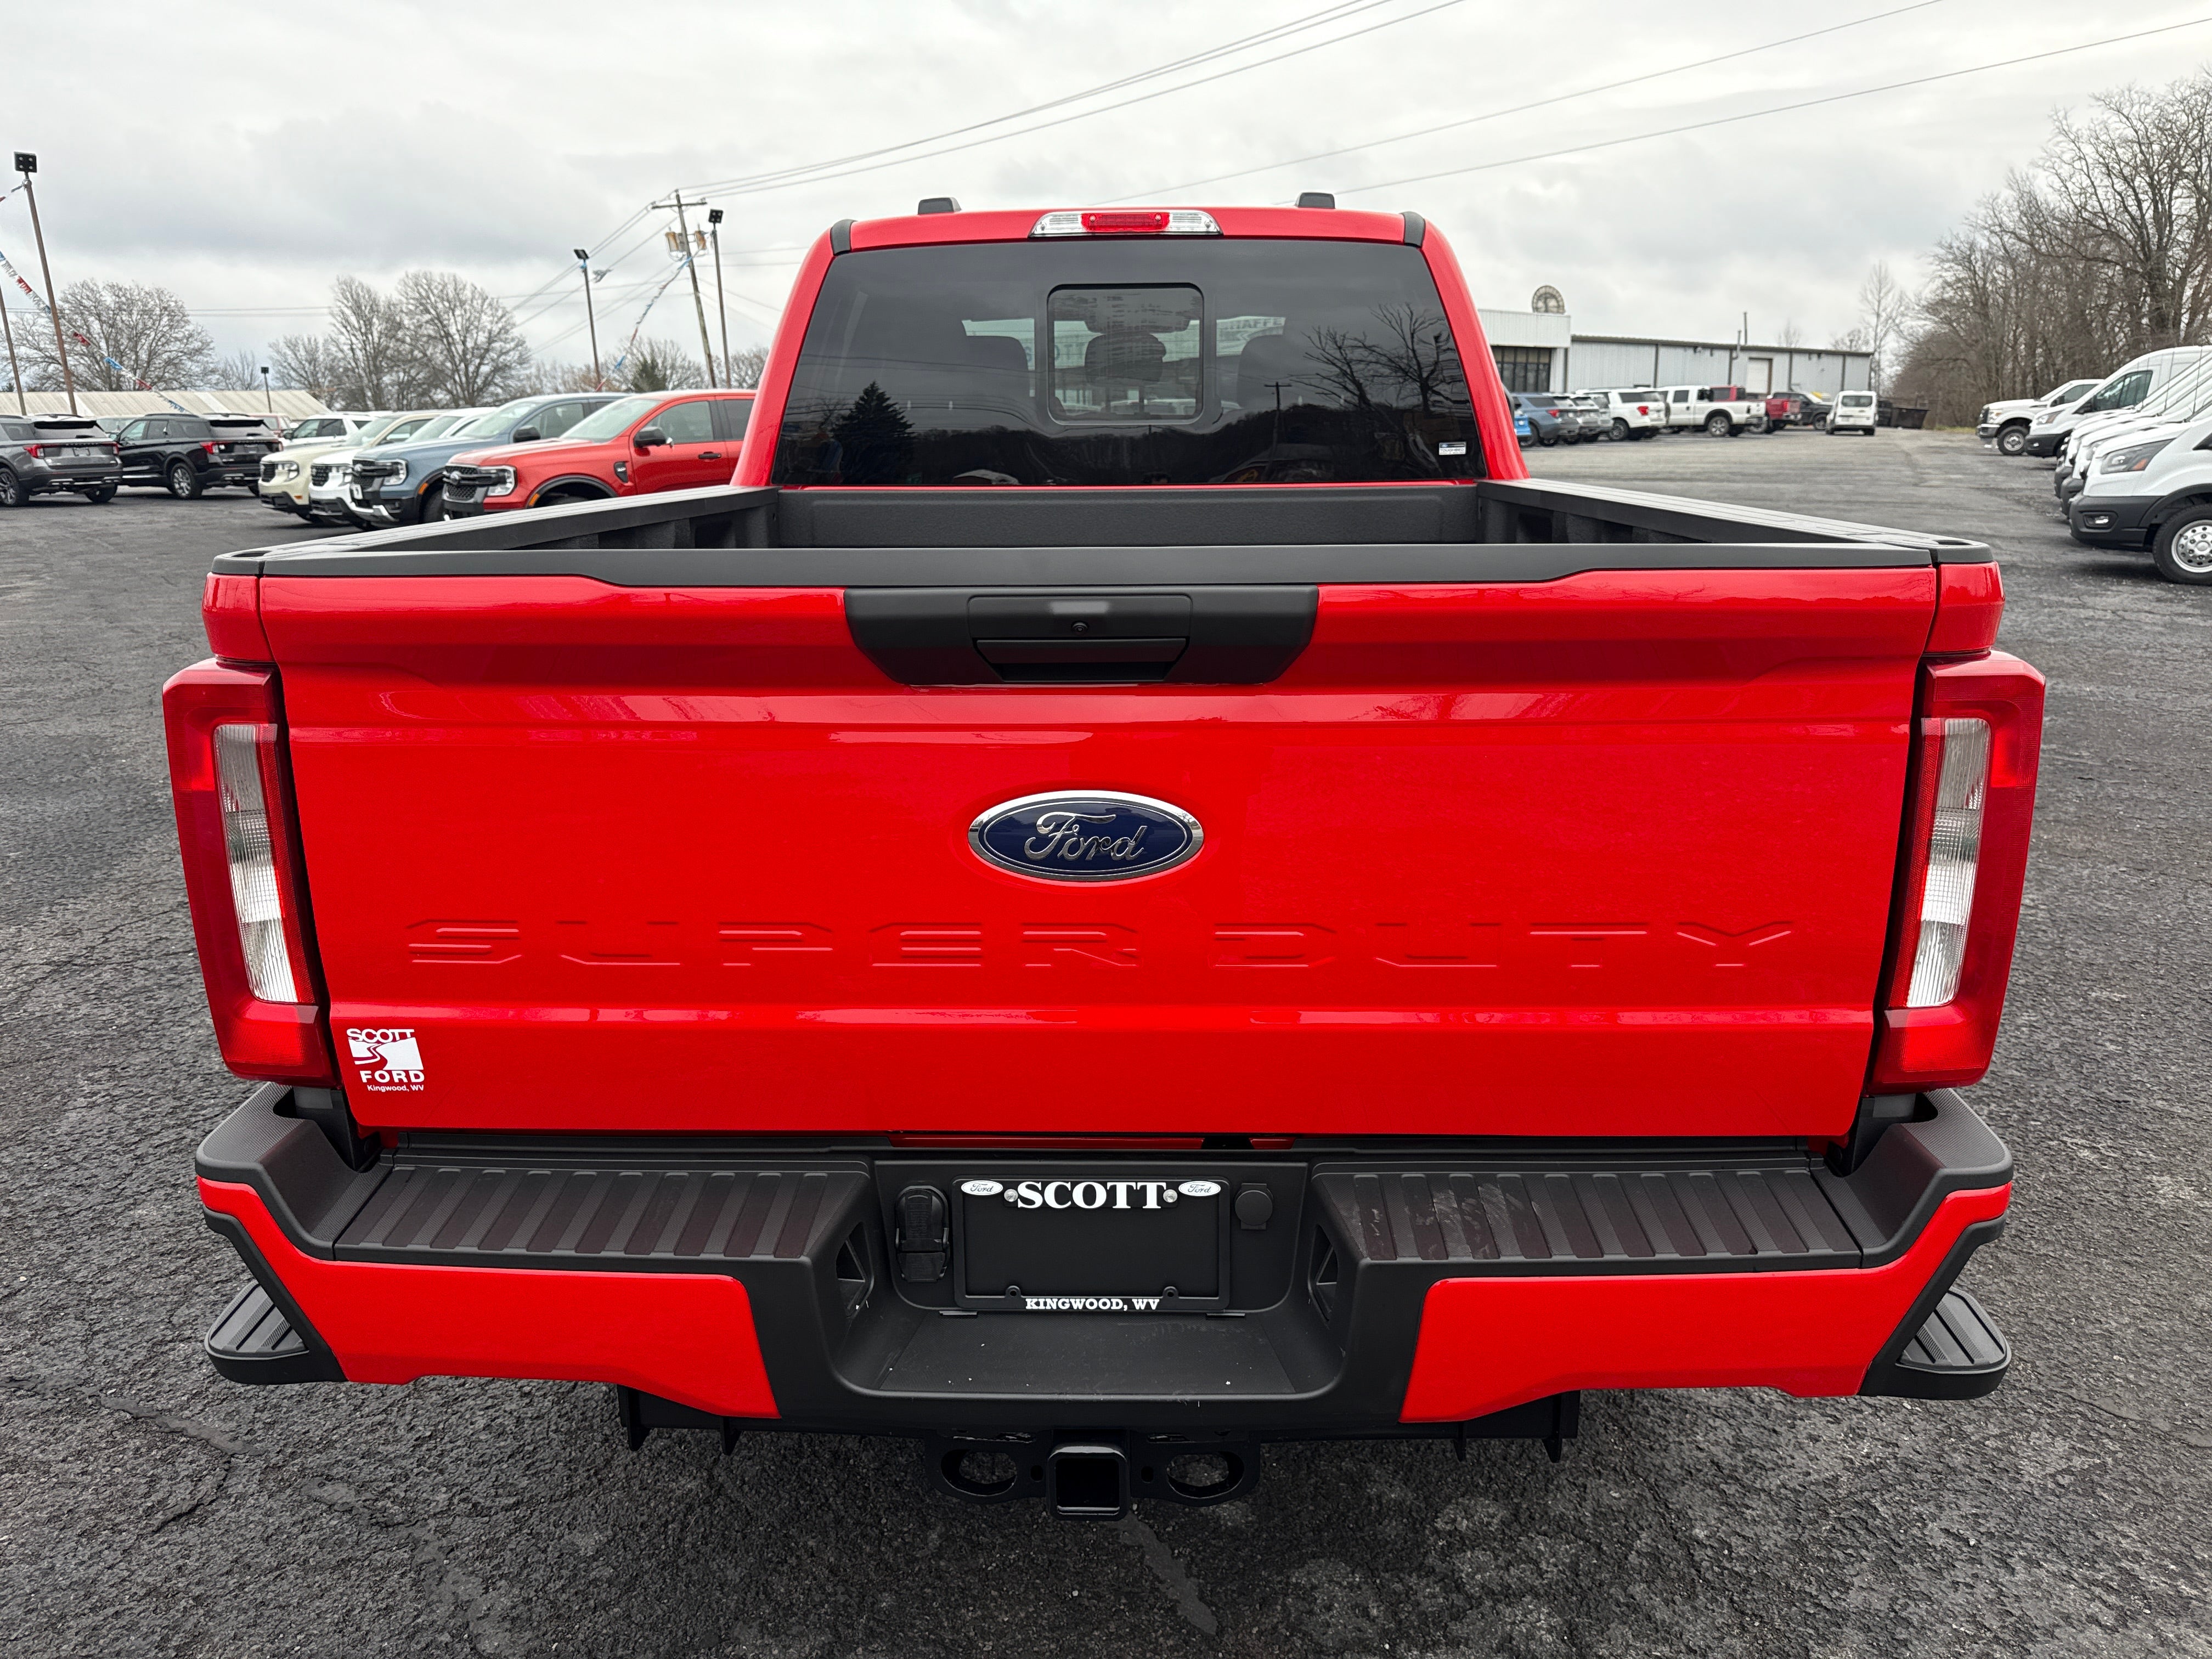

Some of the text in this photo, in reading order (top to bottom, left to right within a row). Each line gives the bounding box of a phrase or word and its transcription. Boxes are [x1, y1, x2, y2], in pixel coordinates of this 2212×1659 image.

[1024, 811, 1148, 861] Ford
[405, 918, 1793, 967] SUPER DUTY
[346, 1028, 415, 1043] SCOTT
[359, 1070, 425, 1084] FORD
[367, 1085, 410, 1093] Kingwood,
[970, 1183, 994, 1192] Ford
[1187, 1184, 1212, 1193] Ford
[1018, 1181, 1167, 1209] SCOTT
[1025, 1298, 1160, 1311] KINGWOOD, WV
